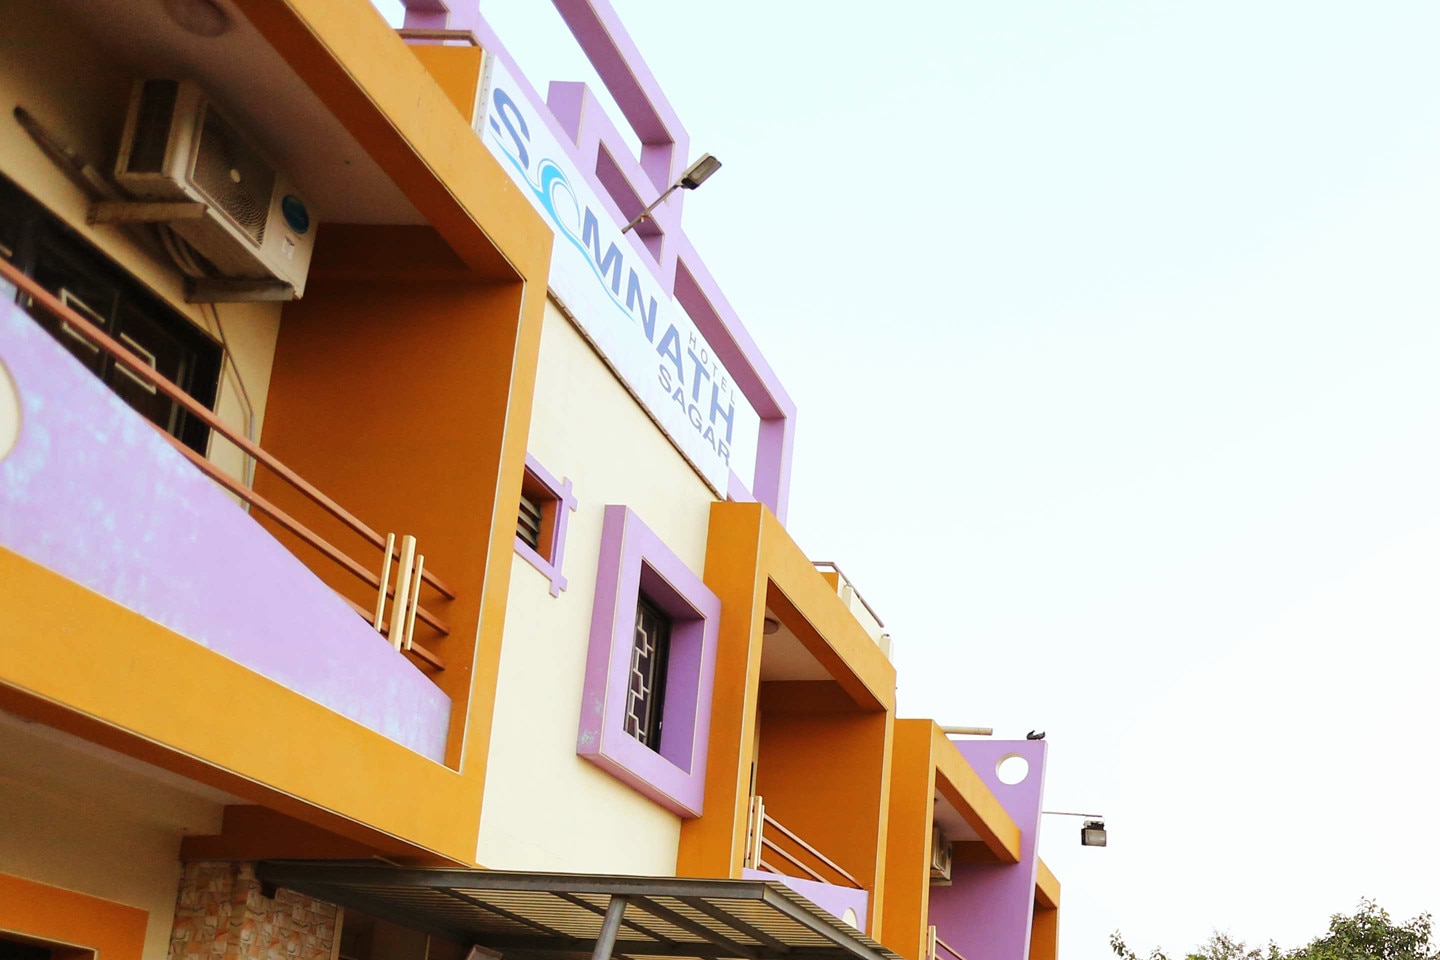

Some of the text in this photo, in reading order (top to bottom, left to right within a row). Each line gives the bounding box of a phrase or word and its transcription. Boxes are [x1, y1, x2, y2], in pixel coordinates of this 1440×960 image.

[489, 87, 735, 446] SOMNATH
[658, 364, 730, 467] SAGAR
[689, 331, 735, 405] HOTEL
